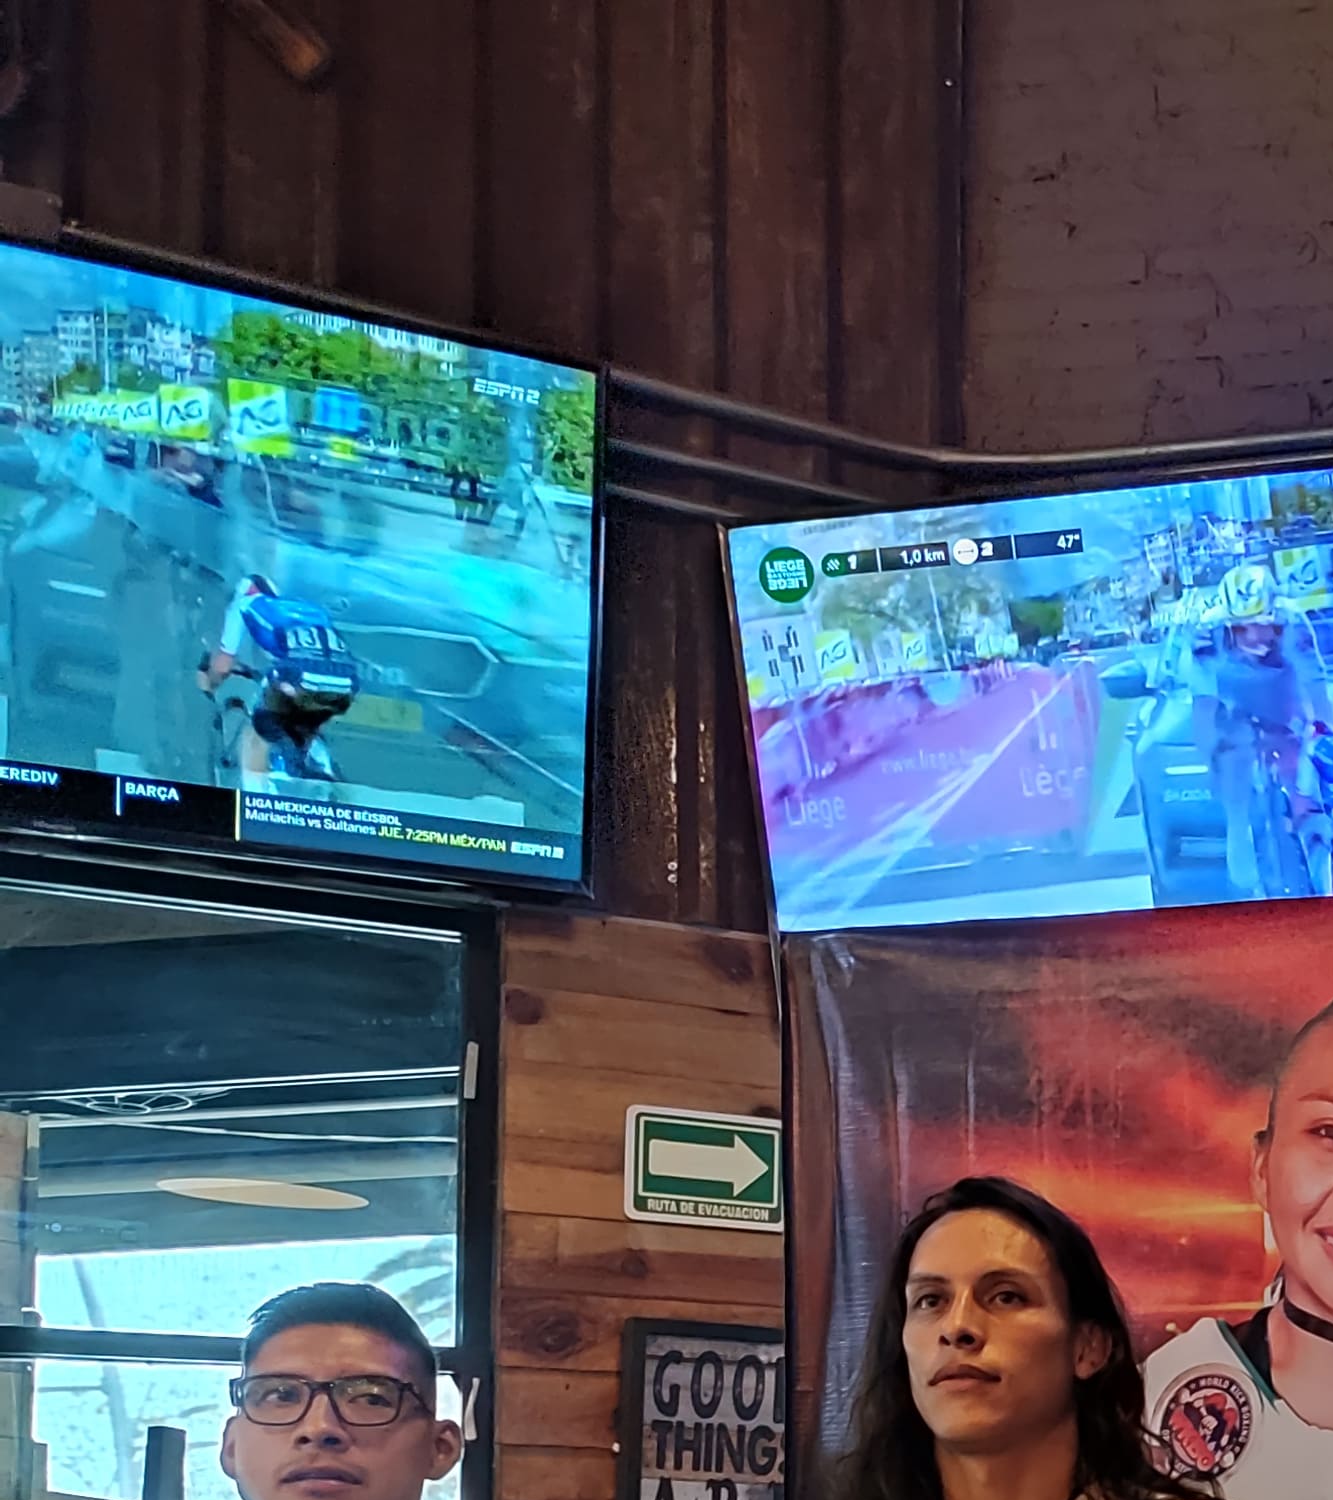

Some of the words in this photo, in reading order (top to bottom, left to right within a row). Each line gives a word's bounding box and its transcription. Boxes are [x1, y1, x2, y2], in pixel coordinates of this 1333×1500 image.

[765, 558, 805, 573] LIEGE
[924, 549, 946, 562] km
[125, 781, 180, 801] BARÇA
[245, 796, 273, 810] LIGA
[274, 800, 334, 818] MEXICANA
[335, 808, 351, 820] DE
[245, 807, 306, 827] Mariachis
[307, 818, 323, 829] vs
[324, 817, 377, 835] Sultanes
[405, 827, 449, 846] 7:25PM
[647, 1199, 678, 1213] RUTA
[681, 1201, 696, 1215] DE
[698, 1203, 769, 1221] EVACUACION
